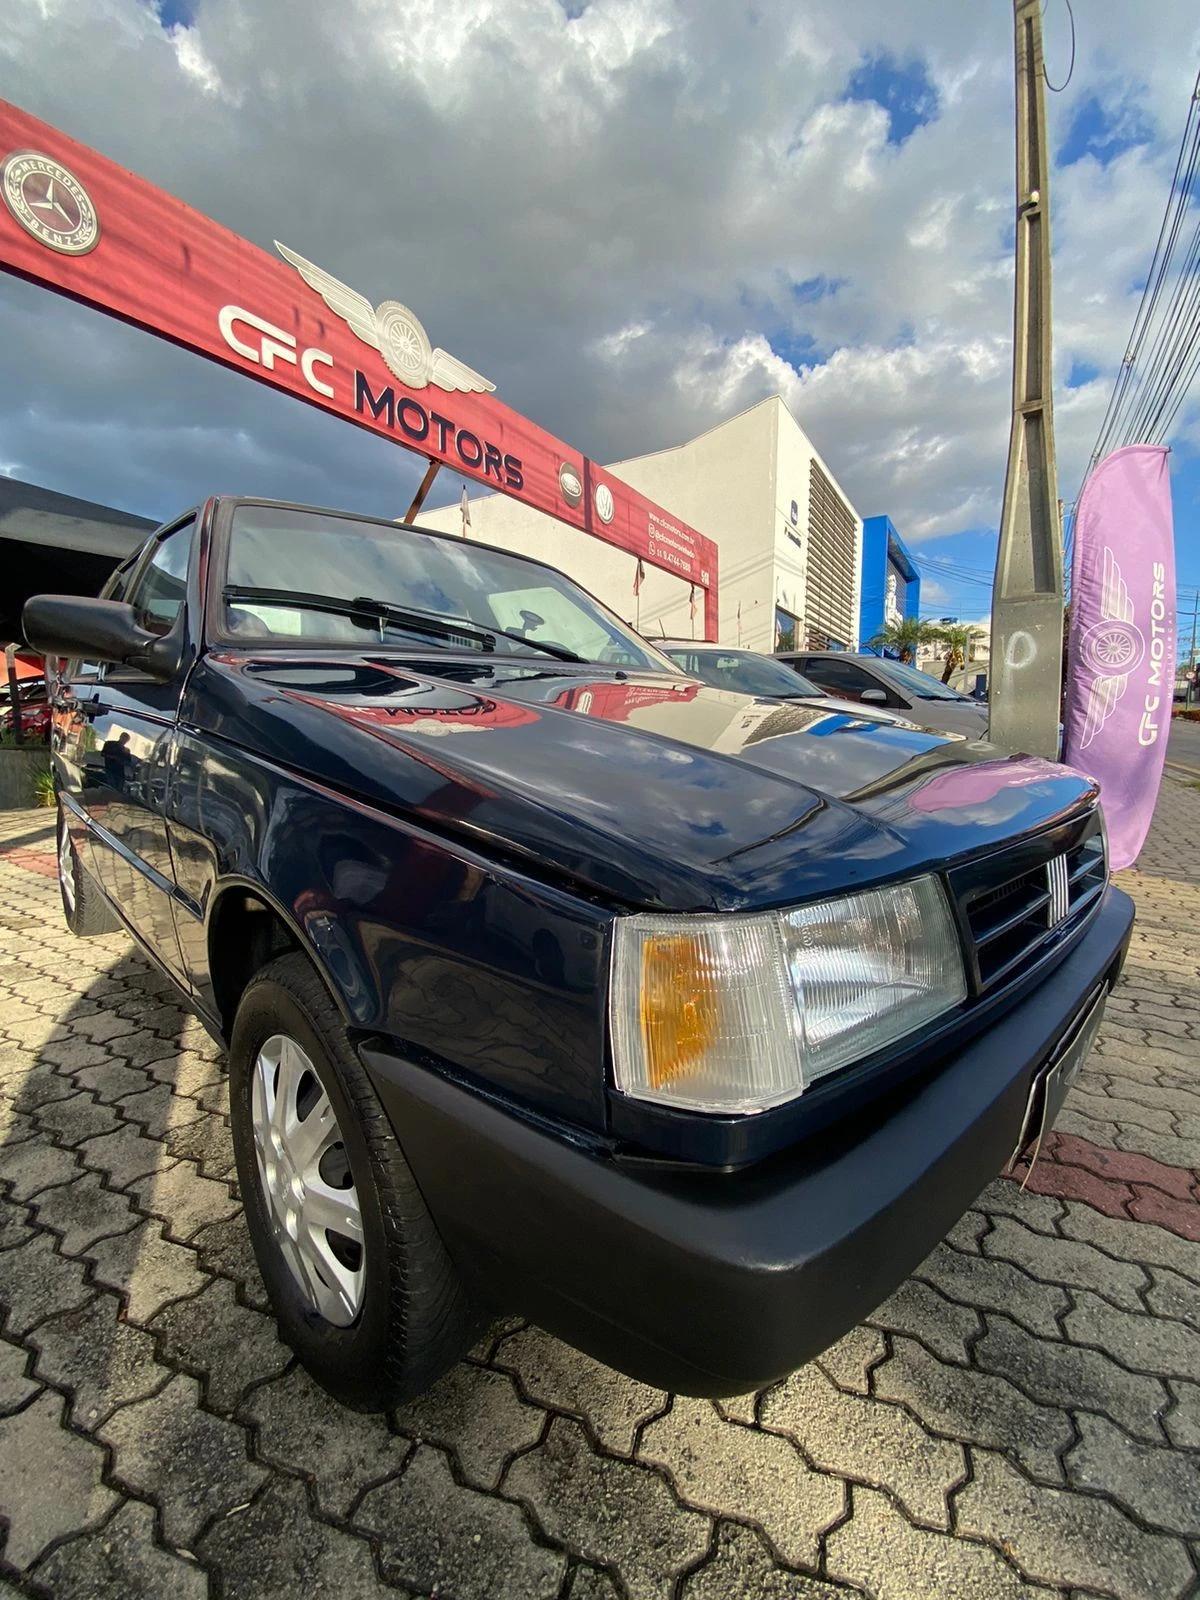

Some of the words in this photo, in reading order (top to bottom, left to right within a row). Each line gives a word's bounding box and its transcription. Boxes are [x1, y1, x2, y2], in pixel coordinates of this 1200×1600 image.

[20, 161, 85, 204] MERCEDES
[30, 218, 76, 246] BENZ
[218, 304, 334, 399] CFC
[353, 368, 524, 491] MOTORS
[1148, 561, 1166, 687] MOTORS
[1138, 694, 1160, 747] CFC
